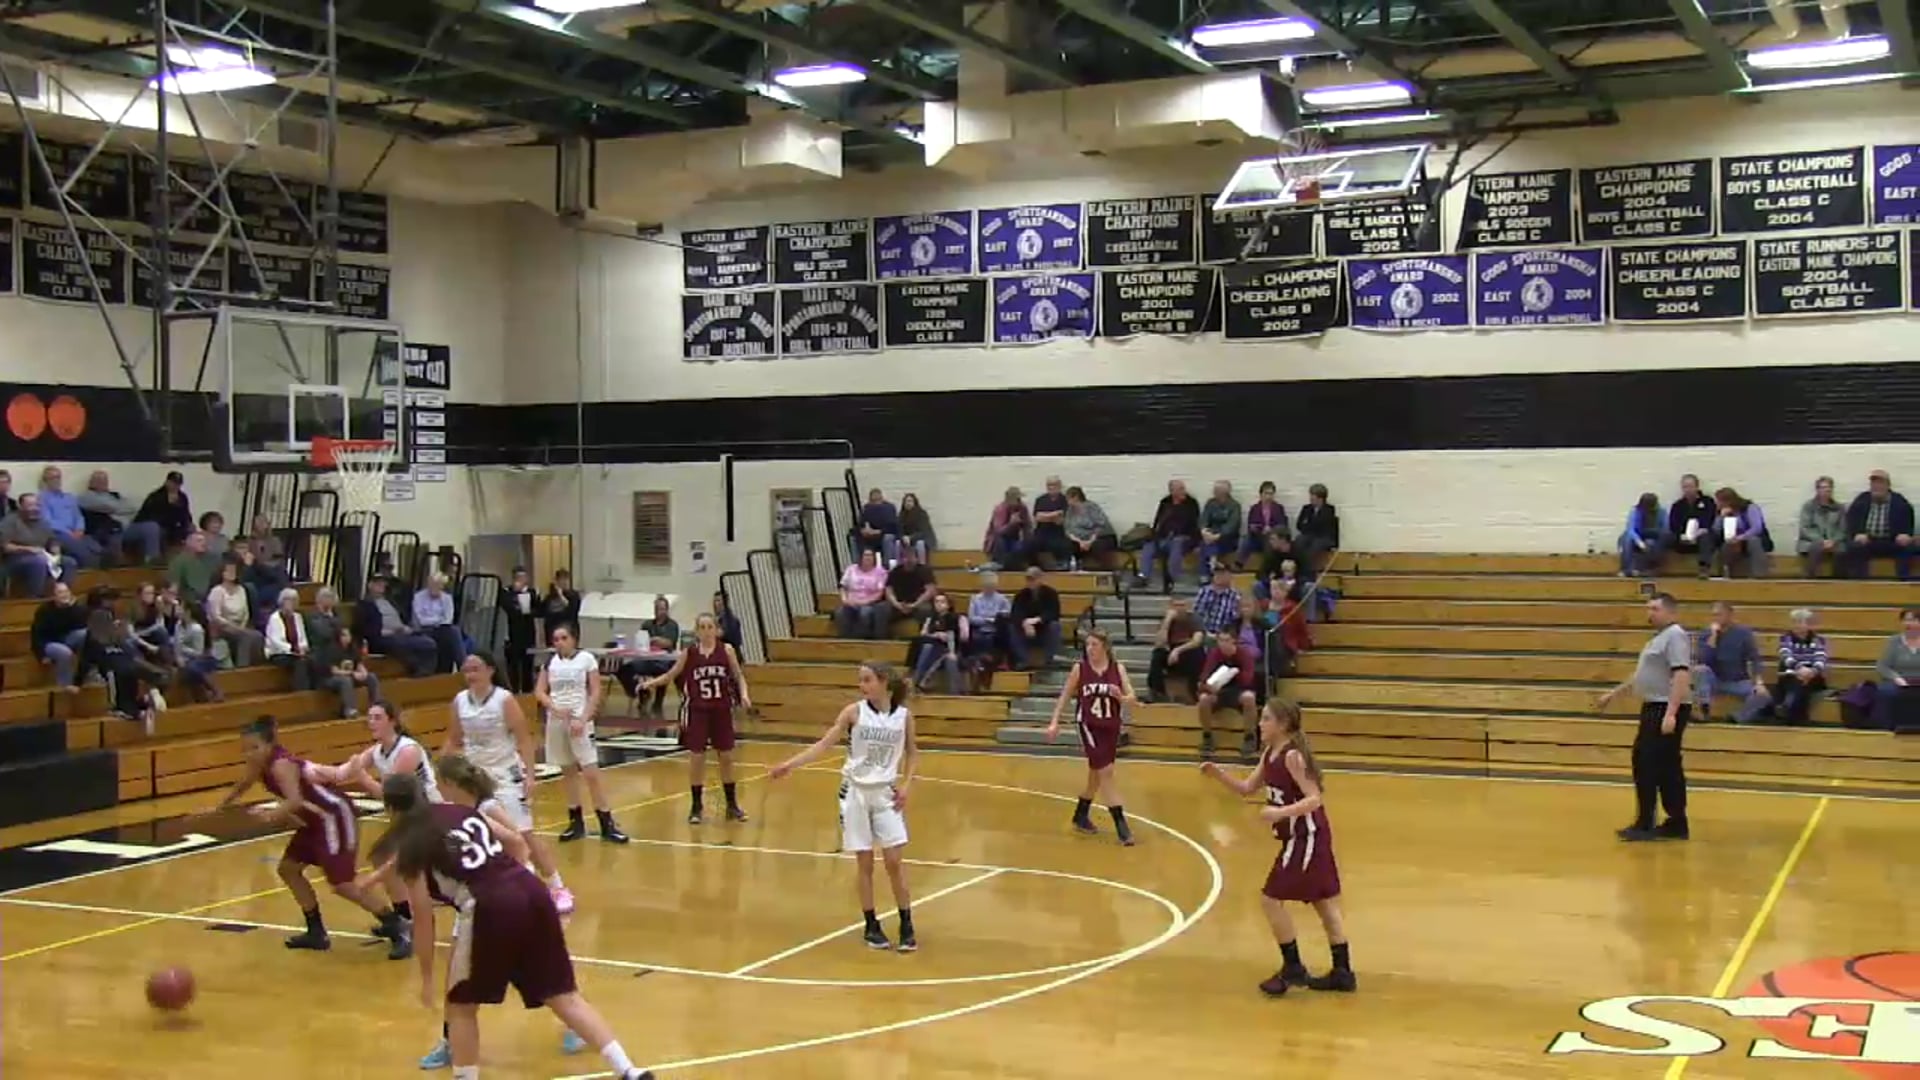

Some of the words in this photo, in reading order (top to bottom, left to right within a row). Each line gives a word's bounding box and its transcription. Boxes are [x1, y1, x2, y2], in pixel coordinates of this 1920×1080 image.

[1731, 161, 1773, 176] STATE
[1778, 154, 1854, 173] CHAMPIONS
[1879, 153, 1912, 177] GOOD
[1519, 174, 1557, 187] MAINE
[1595, 167, 1653, 184] EASTERN
[1657, 163, 1697, 179] MAINE
[1601, 179, 1691, 198] CHAMPIONS
[1727, 180, 1762, 194] BOYS
[1767, 173, 1857, 193] BASKETBALL
[1884, 187, 1917, 199] EAST
[1088, 201, 1149, 216] EASTERN
[1152, 198, 1193, 212] MAINE
[1624, 196, 1667, 208] 2004
[1754, 195, 1811, 210] CLASS
[1818, 193, 1831, 205] C
[1488, 205, 1529, 217] 2003
[1588, 211, 1620, 223] BOYS
[1624, 205, 1705, 220] BASKETBALL
[1768, 211, 1814, 225] 2004
[1104, 213, 1179, 230] CHAMPIONS
[1329, 217, 1361, 229] GIRLS
[1505, 216, 1552, 229] SOCCER
[1612, 221, 1666, 235] CLASS
[1670, 221, 1682, 232] C
[1350, 228, 1398, 240] CLASS
[1478, 230, 1526, 242] CLASS
[1530, 229, 1541, 240] C
[790, 235, 852, 250] CHAMPIONS
[1105, 241, 1178, 253] CHEERLEADING
[1362, 241, 1399, 253] 2002
[1760, 242, 1801, 256] STATE
[37, 243, 112, 266] CHAMPONS
[1621, 251, 1661, 266] STATE
[1665, 247, 1737, 263] CHAMPIONS
[1759, 257, 1802, 272] EASTERN
[1806, 254, 1837, 269] MAINE
[1843, 251, 1897, 267] CHAMPIONS
[1481, 260, 1508, 282] GOOD
[1512, 251, 1597, 277] SPORTSMANSHIP
[1522, 263, 1558, 275] AWARD
[1116, 273, 1164, 286] EASTERN
[1167, 270, 1200, 283] MAINE
[1264, 267, 1337, 286] CHAMPIONS
[1352, 269, 1376, 290] GOOD
[1381, 258, 1463, 284] SPORTSMANSHIP
[1390, 270, 1424, 283] AWARD
[1619, 265, 1740, 283] CHEERLEADING
[1803, 270, 1849, 283] 2004
[901, 285, 941, 296] EASTERN
[943, 282, 970, 294] MAINE
[1120, 284, 1195, 299] CHAMPIONS
[1230, 284, 1332, 303] CHEERLEADING
[1565, 288, 1592, 300] 2004
[1643, 286, 1697, 298] CLASS
[1703, 285, 1714, 295] C
[1782, 282, 1875, 297] SOFTBALL
[912, 296, 958, 308] CHAMPIONS
[1356, 295, 1382, 307] EAST
[1432, 293, 1460, 304] 2002
[1483, 290, 1512, 303] EAST
[1790, 297, 1848, 310] CLASS
[1853, 295, 1865, 307] C
[1141, 299, 1173, 310] 2001
[1250, 305, 1297, 318] CLASS
[1656, 301, 1700, 314] 2004
[1000, 311, 1023, 322] EAST
[1121, 310, 1195, 322] CHEERLEADING
[1262, 319, 1301, 332] 2002
[916, 331, 945, 343] CLASS
[693, 666, 727, 680] LYNX
[700, 679, 721, 699] 51
[1091, 697, 1112, 718] 41
[448, 816, 503, 869] 32
